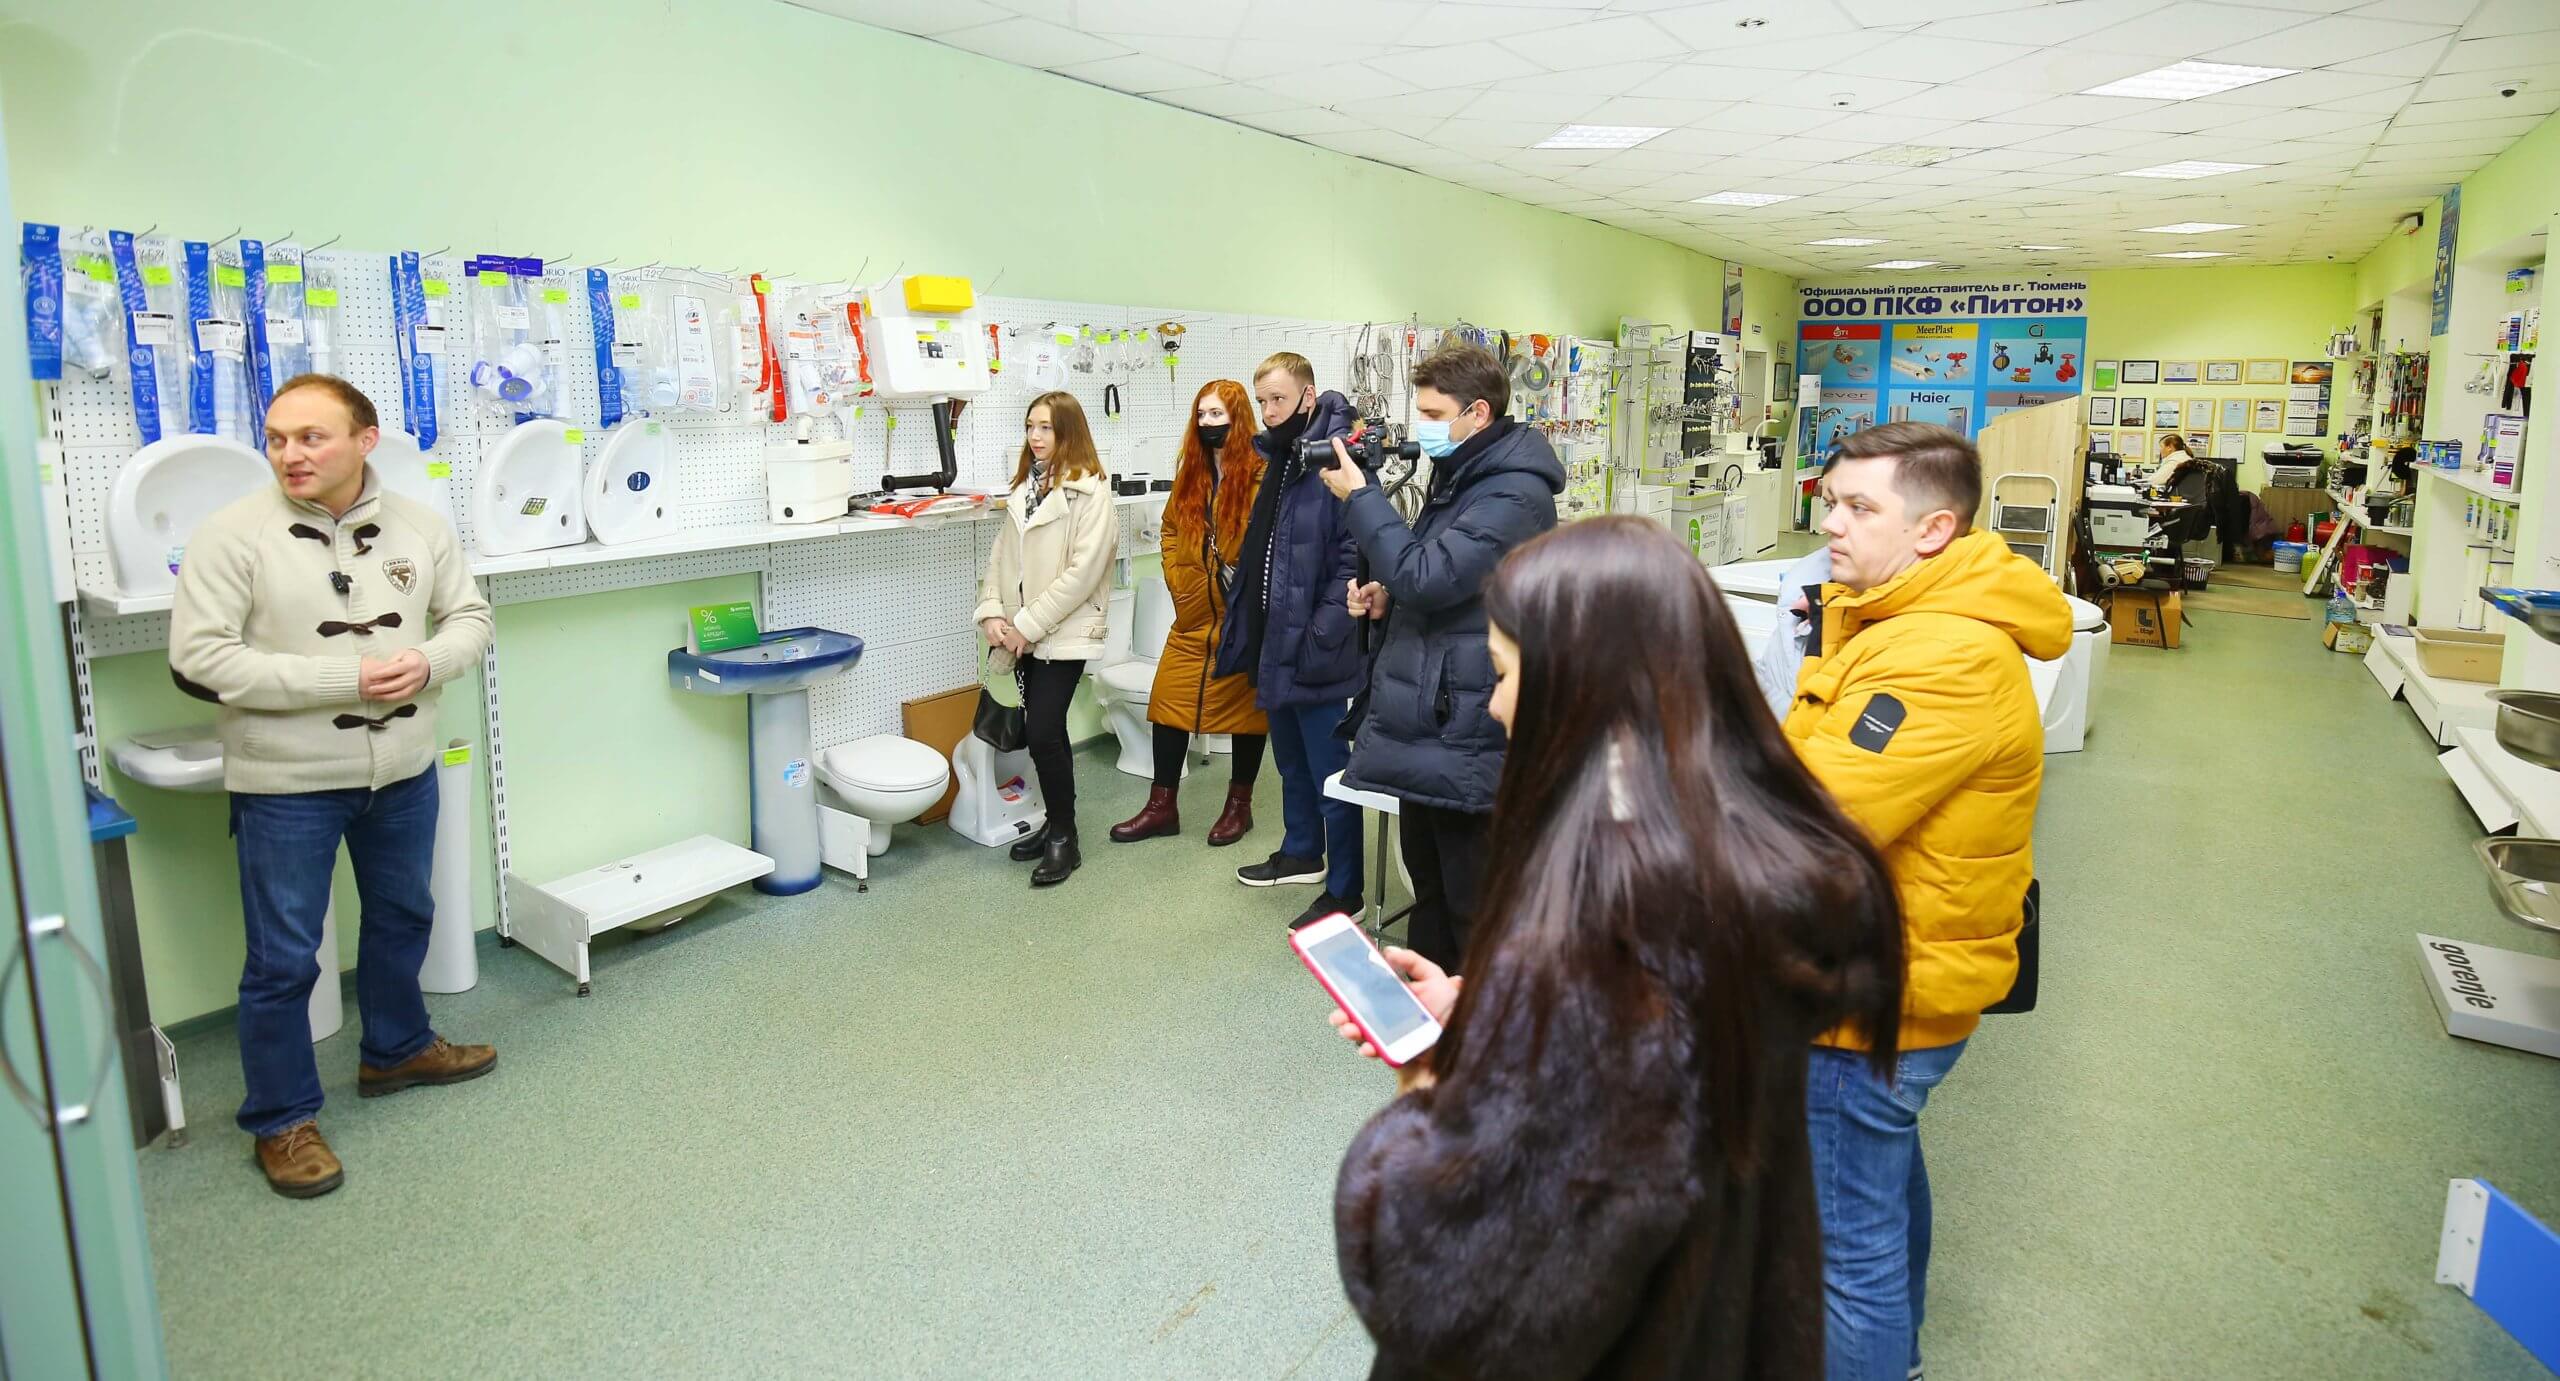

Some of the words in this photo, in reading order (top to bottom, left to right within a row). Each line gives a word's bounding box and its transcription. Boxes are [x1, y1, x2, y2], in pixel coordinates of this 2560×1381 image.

[1898, 284, 1999, 296] представитель
[2002, 284, 2010, 292] в
[2014, 284, 2024, 292] г.
[2028, 281, 2086, 291] Тюмень
[1804, 298, 1867, 317] ООО
[1874, 296, 1943, 316] ПКФ
[1950, 295, 2083, 314] «Питон»
[1917, 325, 1954, 334] MeerPlast
[1911, 392, 1951, 403] Haier
[2429, 942, 2497, 1008] gorenje
